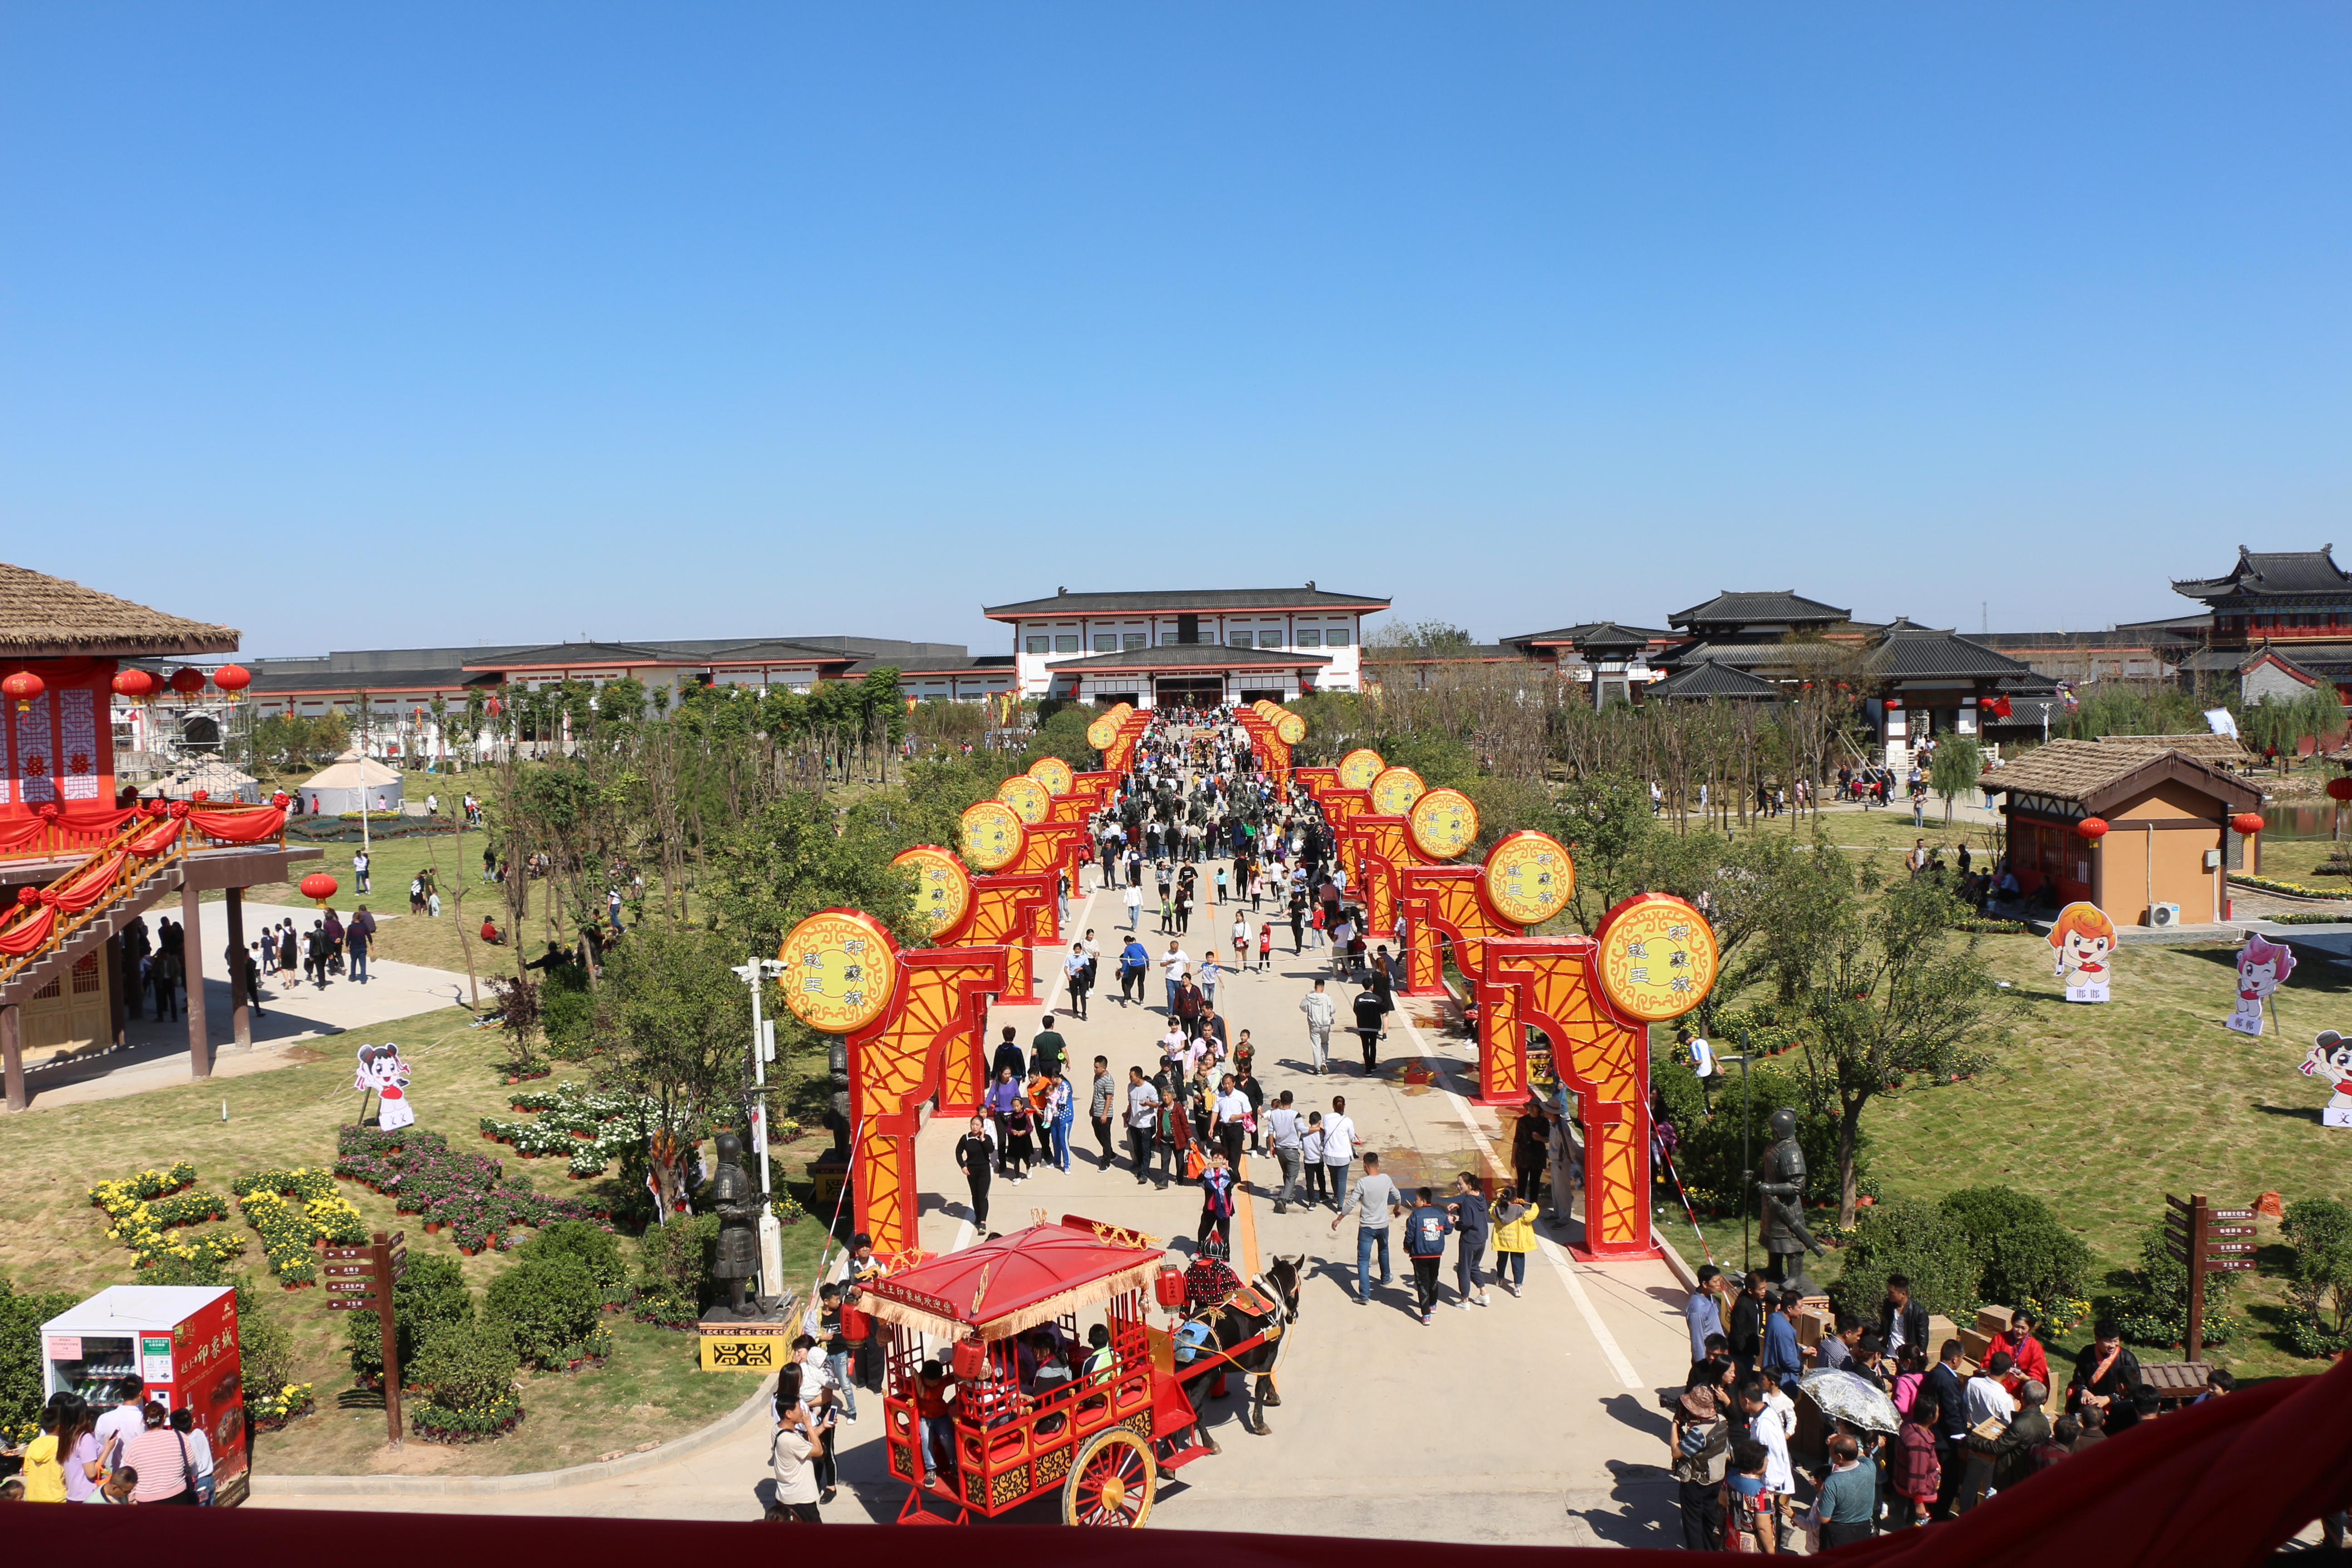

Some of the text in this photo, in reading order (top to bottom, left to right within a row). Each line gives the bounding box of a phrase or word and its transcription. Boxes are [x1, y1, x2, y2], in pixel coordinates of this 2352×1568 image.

[1007, 796, 1016, 809] 赵
[1026, 789, 1035, 820] 印象城
[1384, 789, 1394, 807] 赵王
[970, 825, 983, 848] 赵王
[994, 817, 1006, 855] 印象城
[1427, 814, 1439, 837] 赵王
[1450, 805, 1463, 844] 印象城
[931, 870, 947, 919] 印象城
[1507, 866, 1524, 896] 赵王
[1537, 854, 1553, 903] 印象城
[804, 953, 824, 993] 赵王
[844, 940, 865, 1006] 印象城
[1627, 943, 1651, 984] 赵王
[1668, 926, 1692, 992] 印象城
[388, 1113, 408, 1127] 文文
[2337, 1112, 2350, 1124] 文
[877, 1280, 951, 1313] 赵王印象城欢迎您
